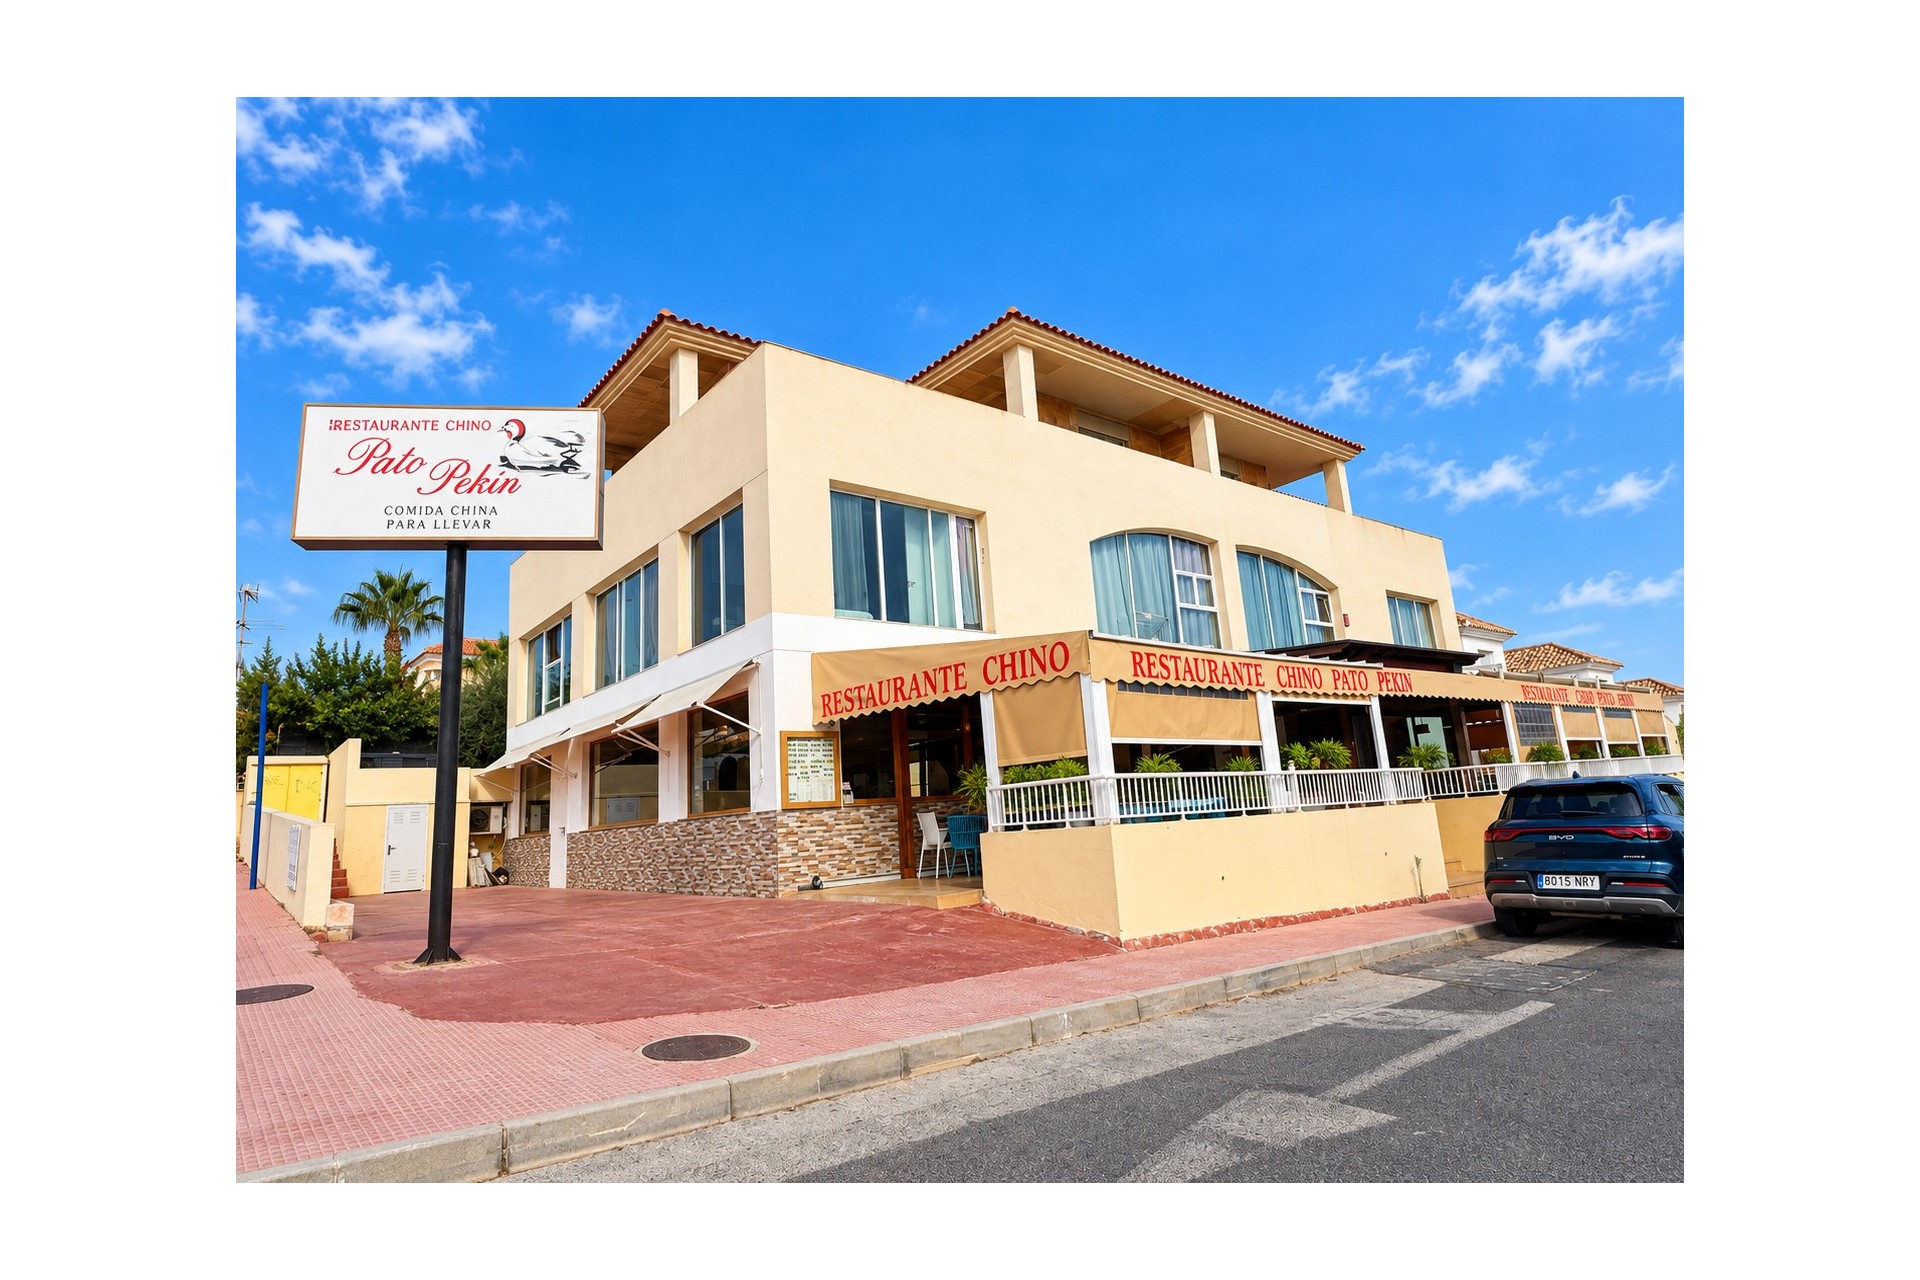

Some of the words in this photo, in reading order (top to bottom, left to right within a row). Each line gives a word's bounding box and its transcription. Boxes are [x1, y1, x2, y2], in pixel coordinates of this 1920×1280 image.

[445, 419, 492, 431] CHINO
[333, 437, 427, 475] Pato
[384, 505, 444, 516] COMIDA
[450, 505, 498, 516] CHINA
[386, 519, 426, 530] PARA
[433, 519, 492, 530] LLEVAR
[1131, 650, 1265, 687] RESTAURANTE
[1276, 665, 1323, 690] CHINO
[1331, 668, 1369, 692] PATO
[1376, 670, 1414, 693] PEKIN
[820, 661, 968, 718] RESTAURANTE
[982, 640, 1070, 686] CHINO
[1544, 876, 1571, 887] 8015
[1574, 876, 1596, 887] NRY
